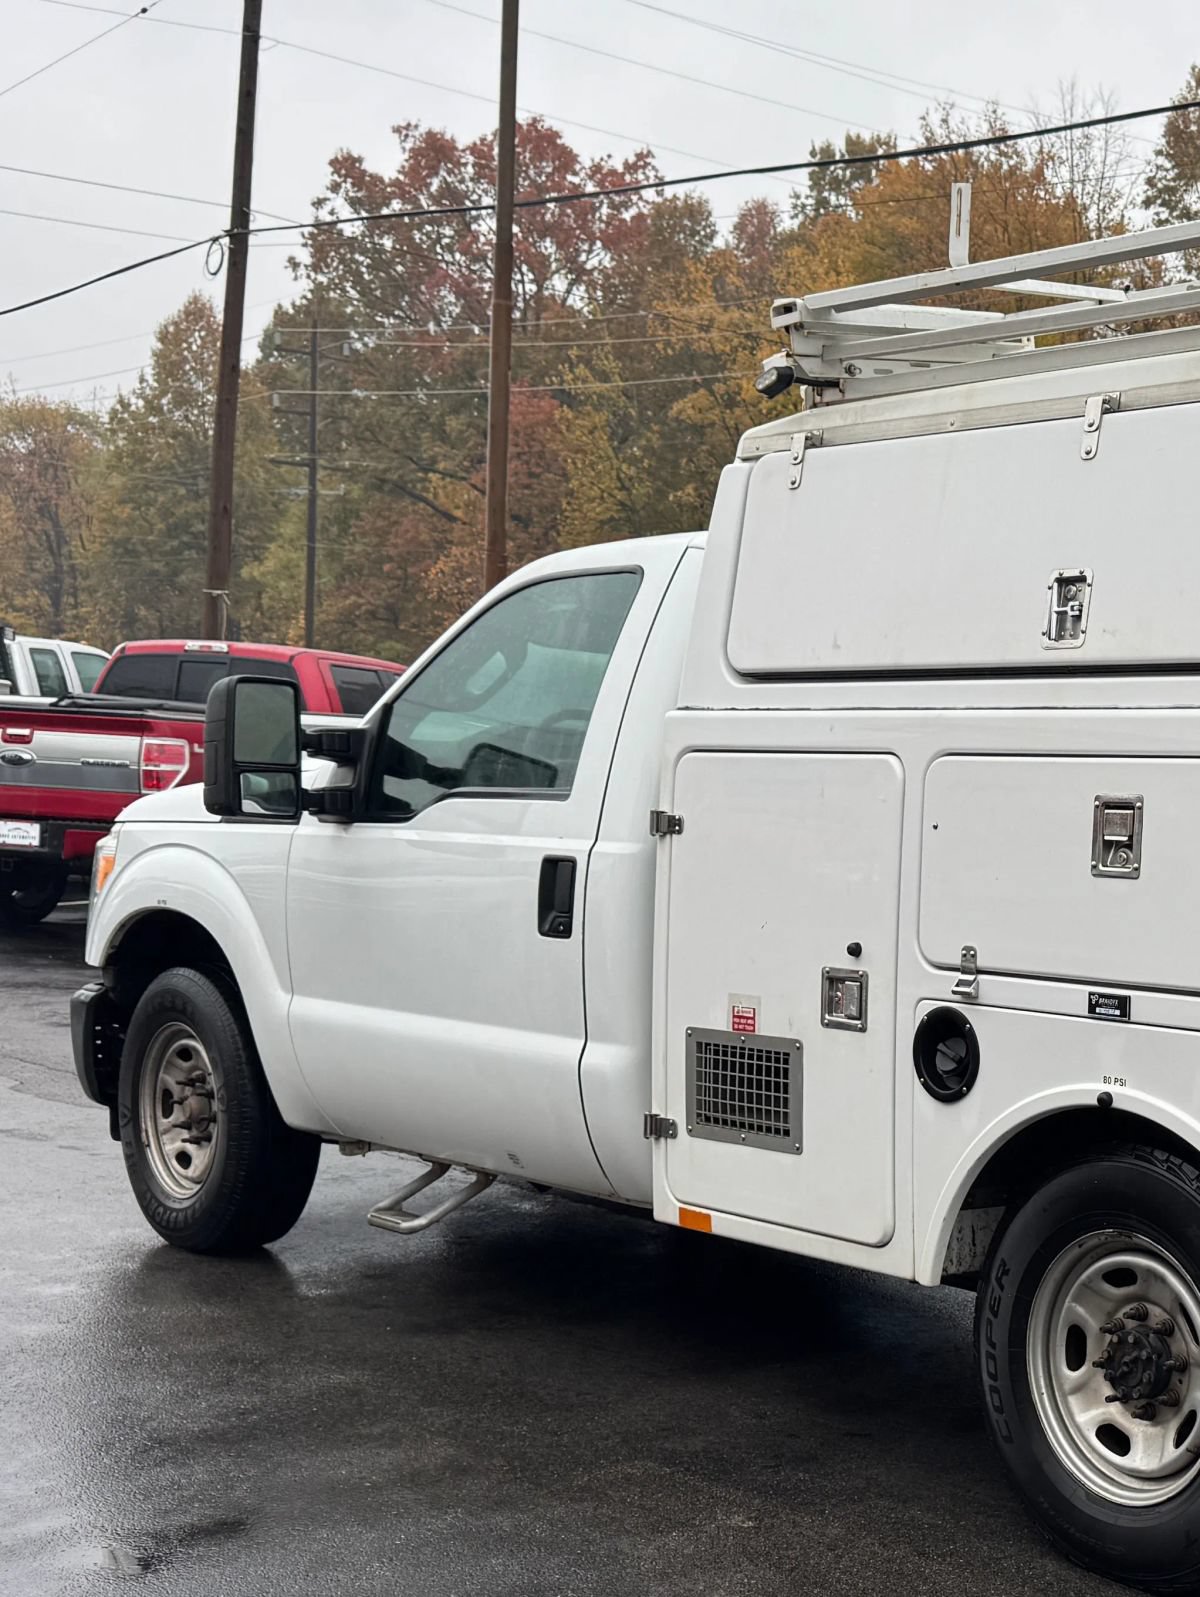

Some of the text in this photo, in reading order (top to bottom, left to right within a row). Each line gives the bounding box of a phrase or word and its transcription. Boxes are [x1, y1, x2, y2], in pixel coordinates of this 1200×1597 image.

[1103, 1075, 1126, 1087] 80 PSI
[985, 1257, 1014, 1444] COOPER
